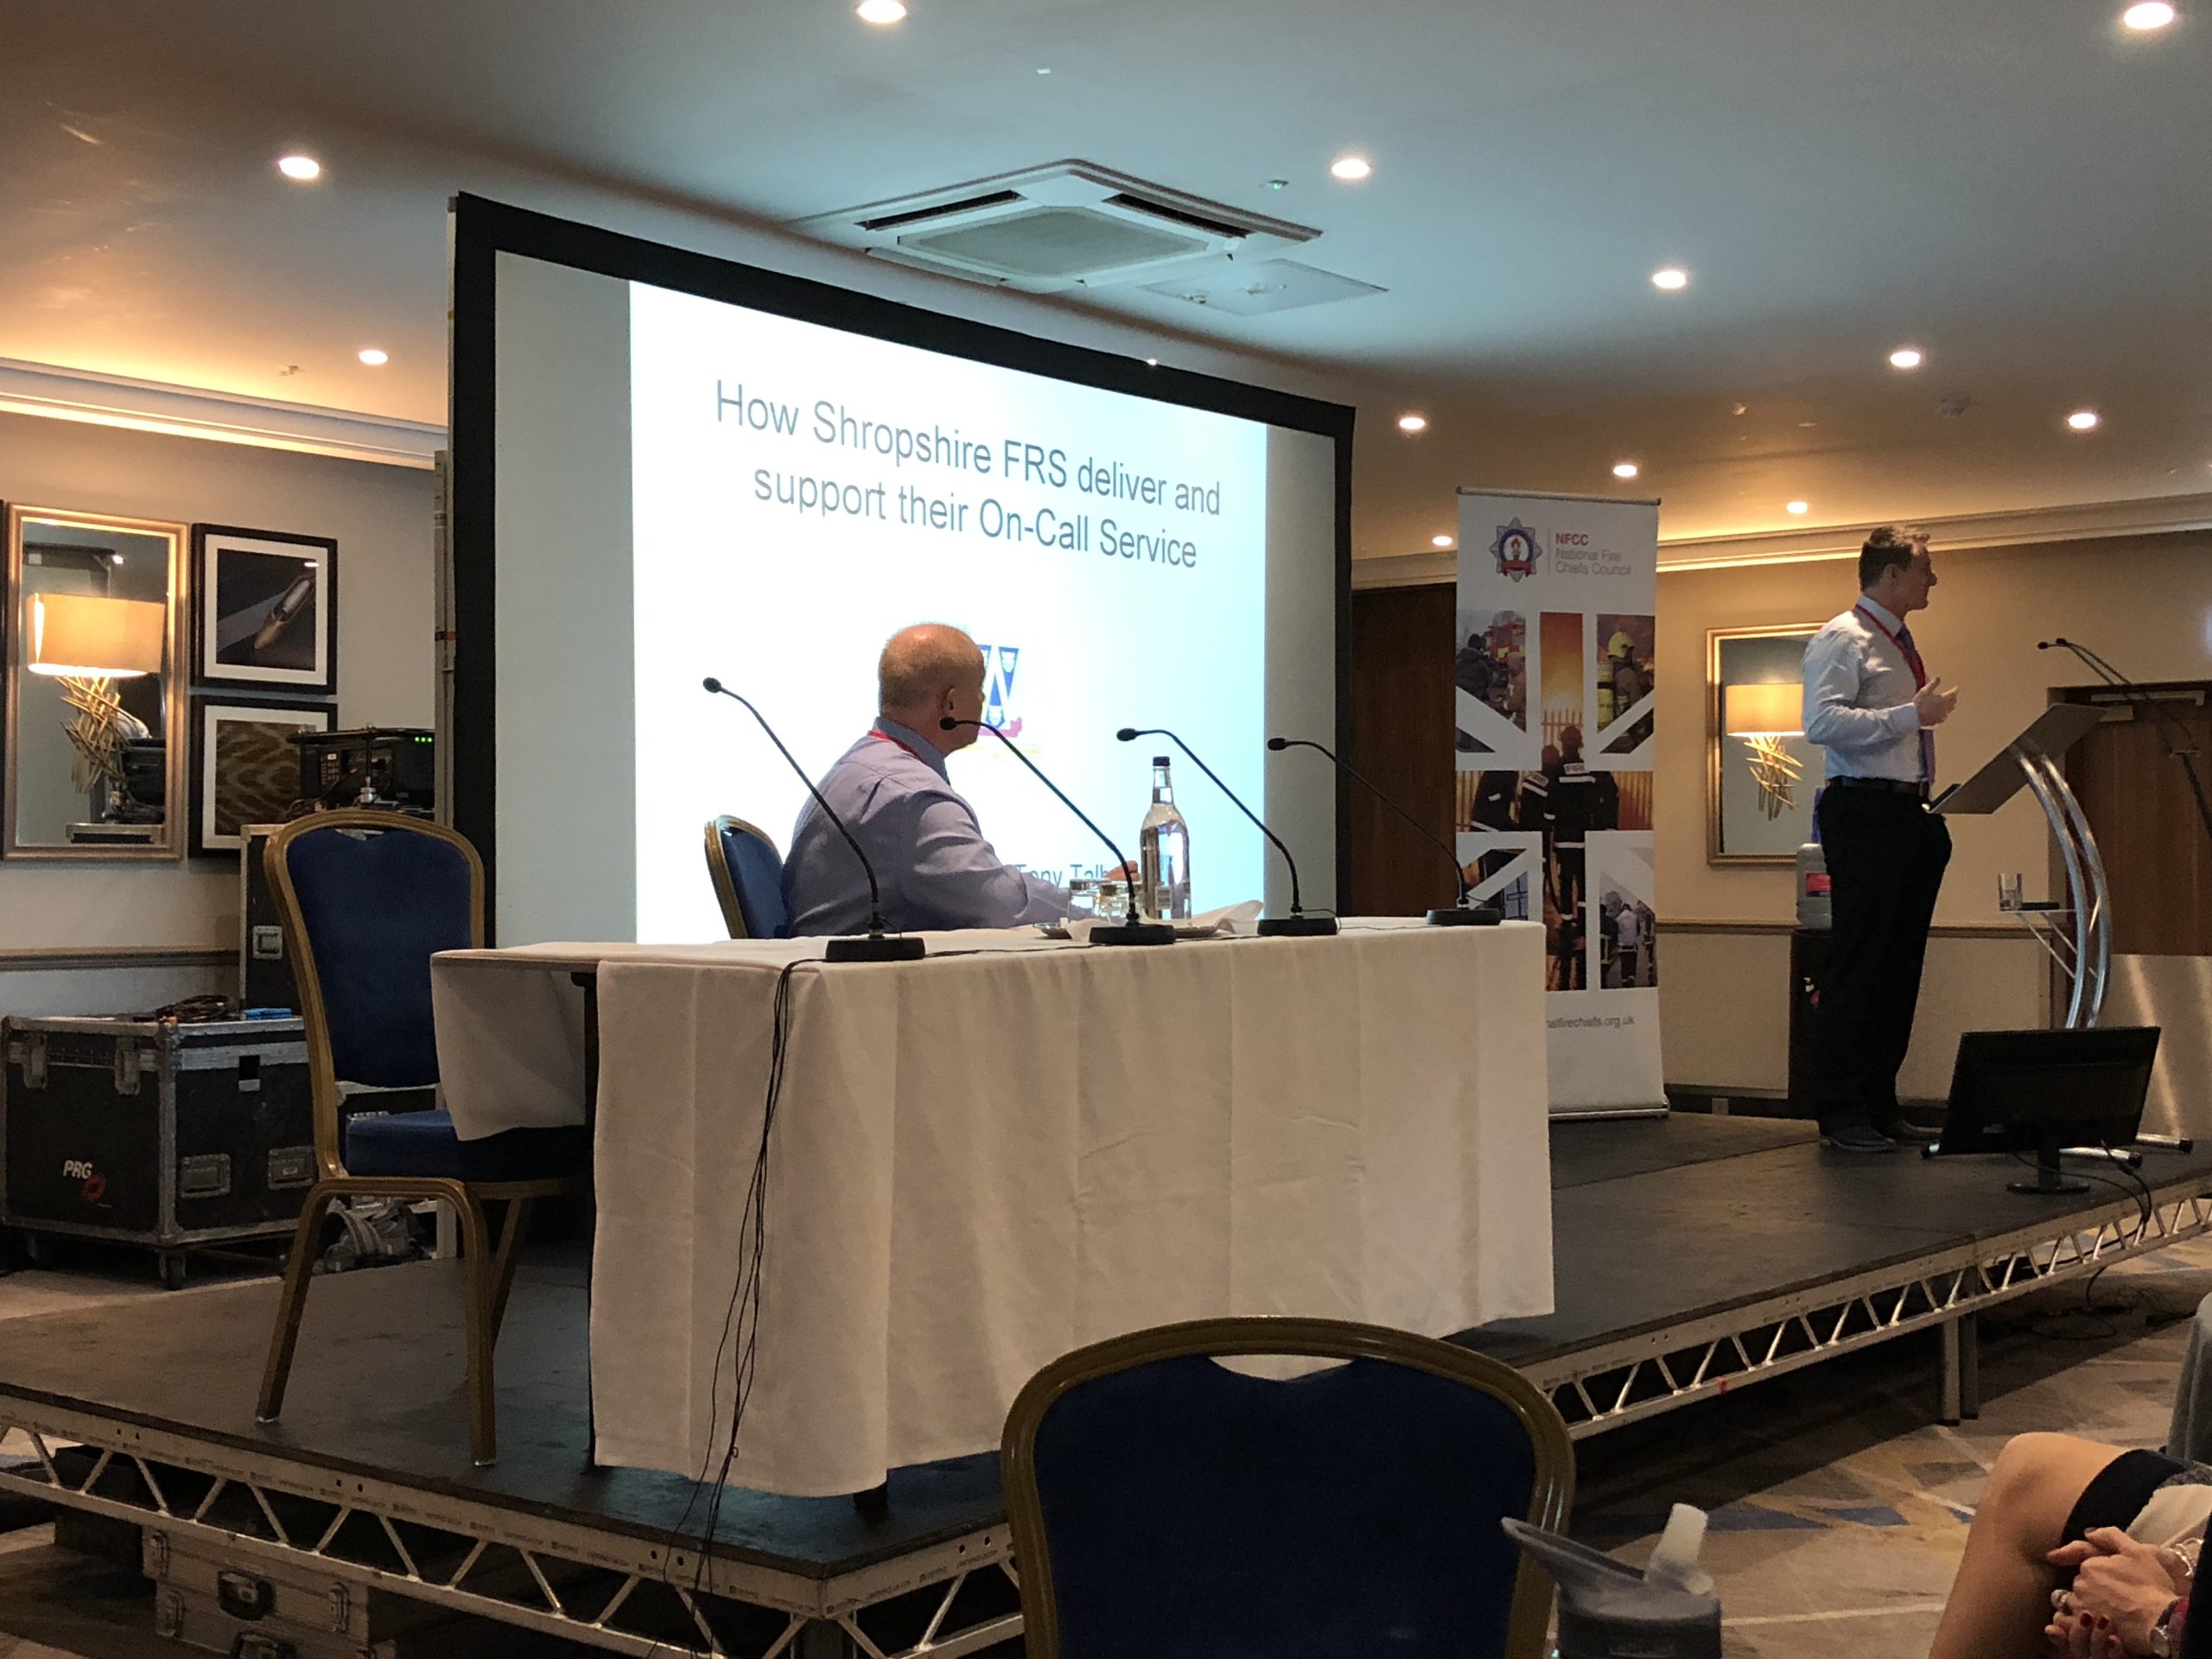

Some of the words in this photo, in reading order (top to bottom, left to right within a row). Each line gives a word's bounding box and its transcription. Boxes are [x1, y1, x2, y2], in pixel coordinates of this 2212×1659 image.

[717, 380, 800, 436] How
[814, 401, 992, 474] Shropshire
[1005, 440, 1068, 488] FRS
[1077, 456, 1167, 507] deliver
[1175, 480, 1221, 517] and
[754, 469, 887, 521] support
[899, 485, 969, 533] their
[979, 498, 1089, 552] On-Call
[1099, 518, 1198, 569] Service
[1554, 532, 1589, 546] NFCC
[1601, 549, 1623, 562] Fire
[1555, 561, 1590, 575] Chiefs
[1592, 563, 1632, 575] Council
[62, 1160, 93, 1179] PRG
